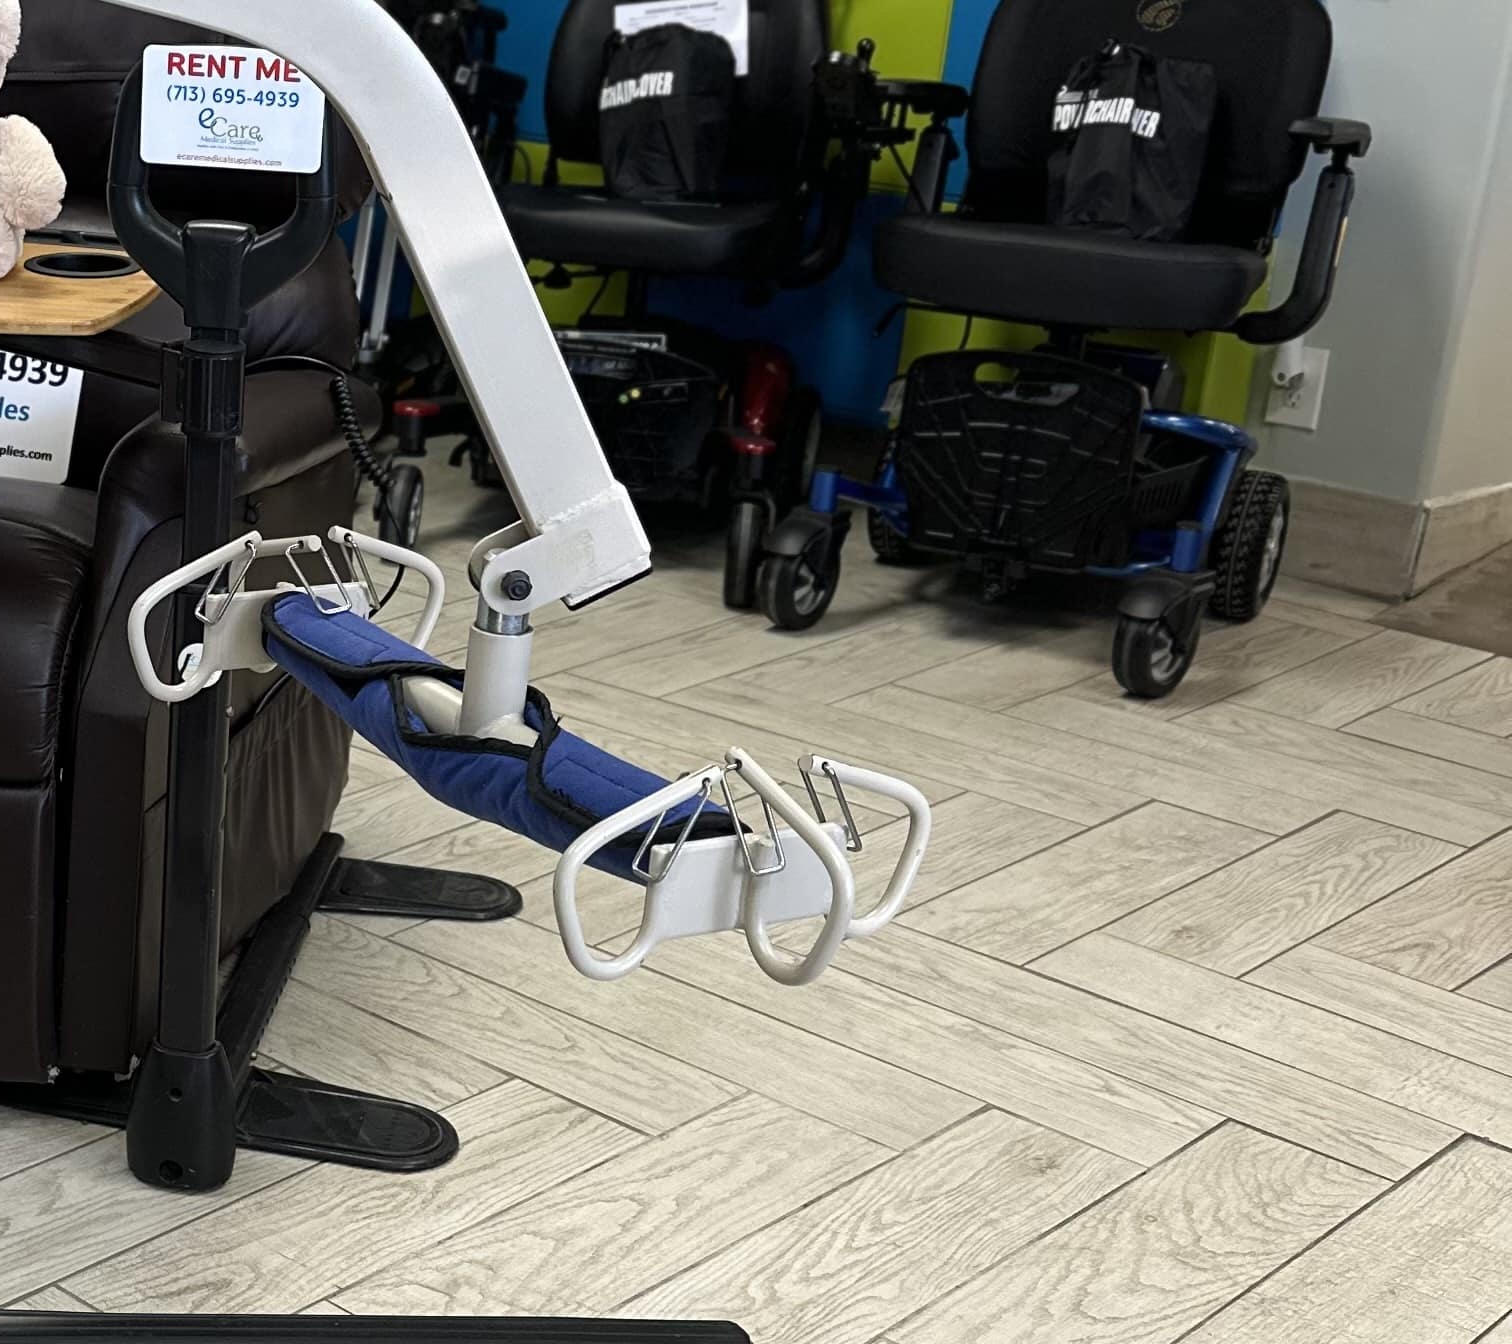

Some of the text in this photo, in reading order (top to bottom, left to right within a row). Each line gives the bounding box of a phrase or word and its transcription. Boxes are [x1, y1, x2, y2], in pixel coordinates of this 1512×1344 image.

[167, 52, 301, 83] RENT ME
[167, 84, 300, 108] (713) 695-4939
[198, 108, 261, 140] eCare
[200, 136, 257, 146] Medical Supplies
[176, 153, 283, 167] ecaremedicalsupplies.com
